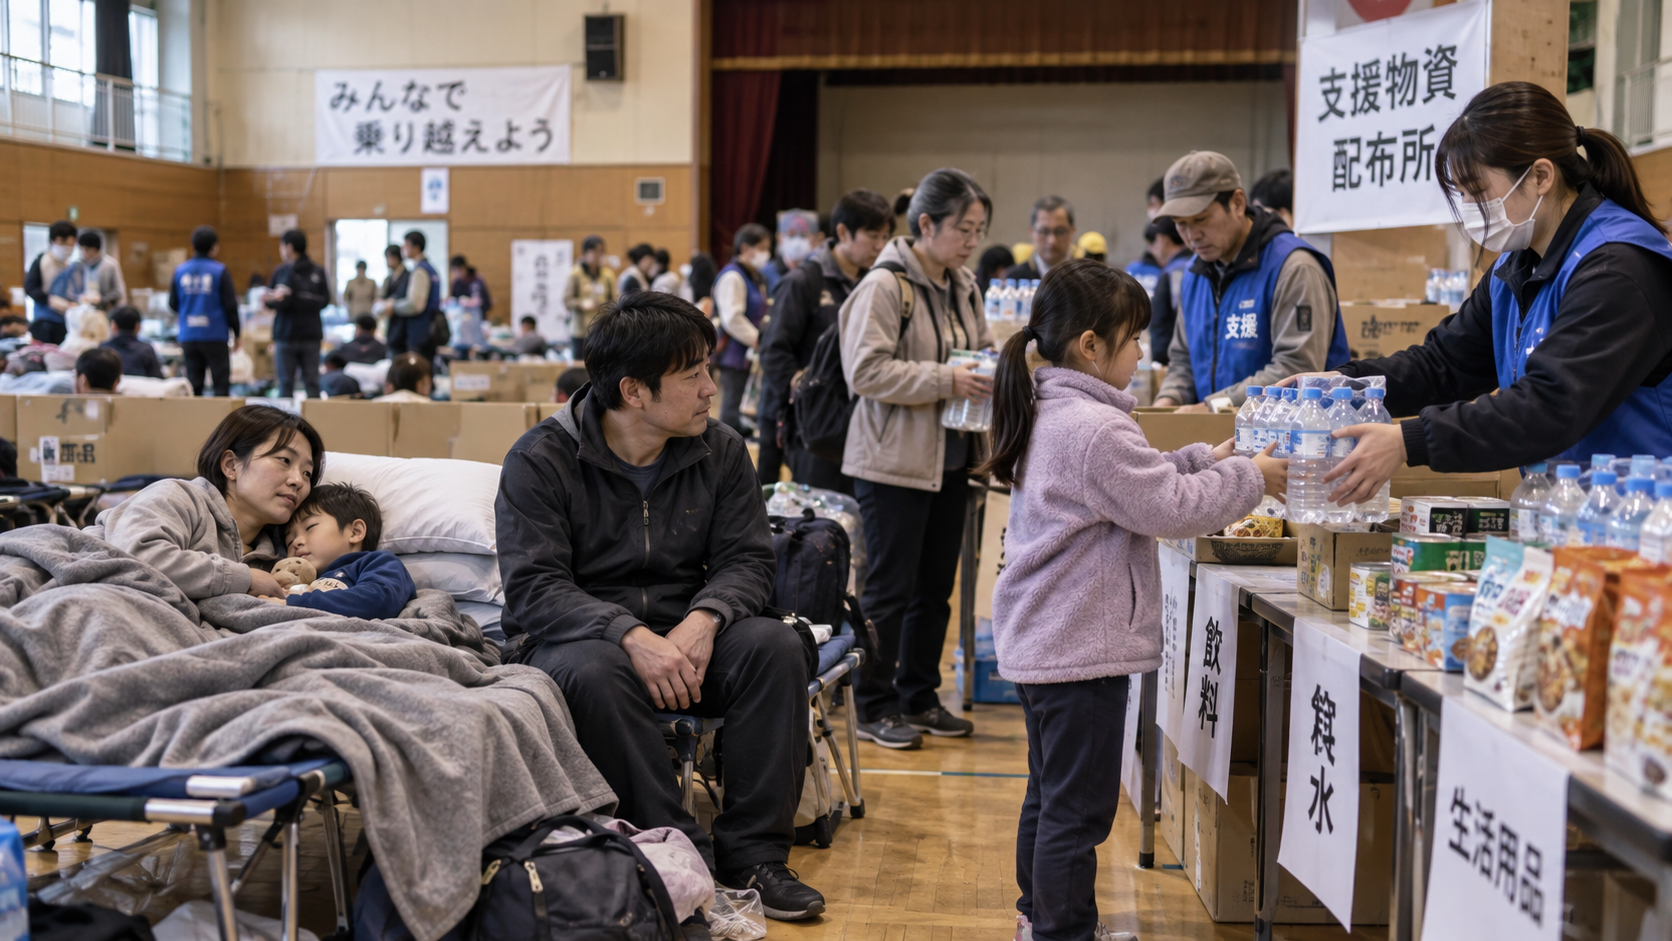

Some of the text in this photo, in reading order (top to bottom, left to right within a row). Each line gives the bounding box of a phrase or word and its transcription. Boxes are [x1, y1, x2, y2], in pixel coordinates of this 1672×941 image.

[329, 79, 468, 112] みんなで
[1318, 44, 1458, 123] 支援物資
[353, 118, 555, 155] 乗り越えよう
[1332, 123, 1436, 192] 配布所
[1225, 313, 1259, 340] 支援
[1198, 616, 1223, 739] 飲料
[1448, 786, 1544, 930] 生活用品
